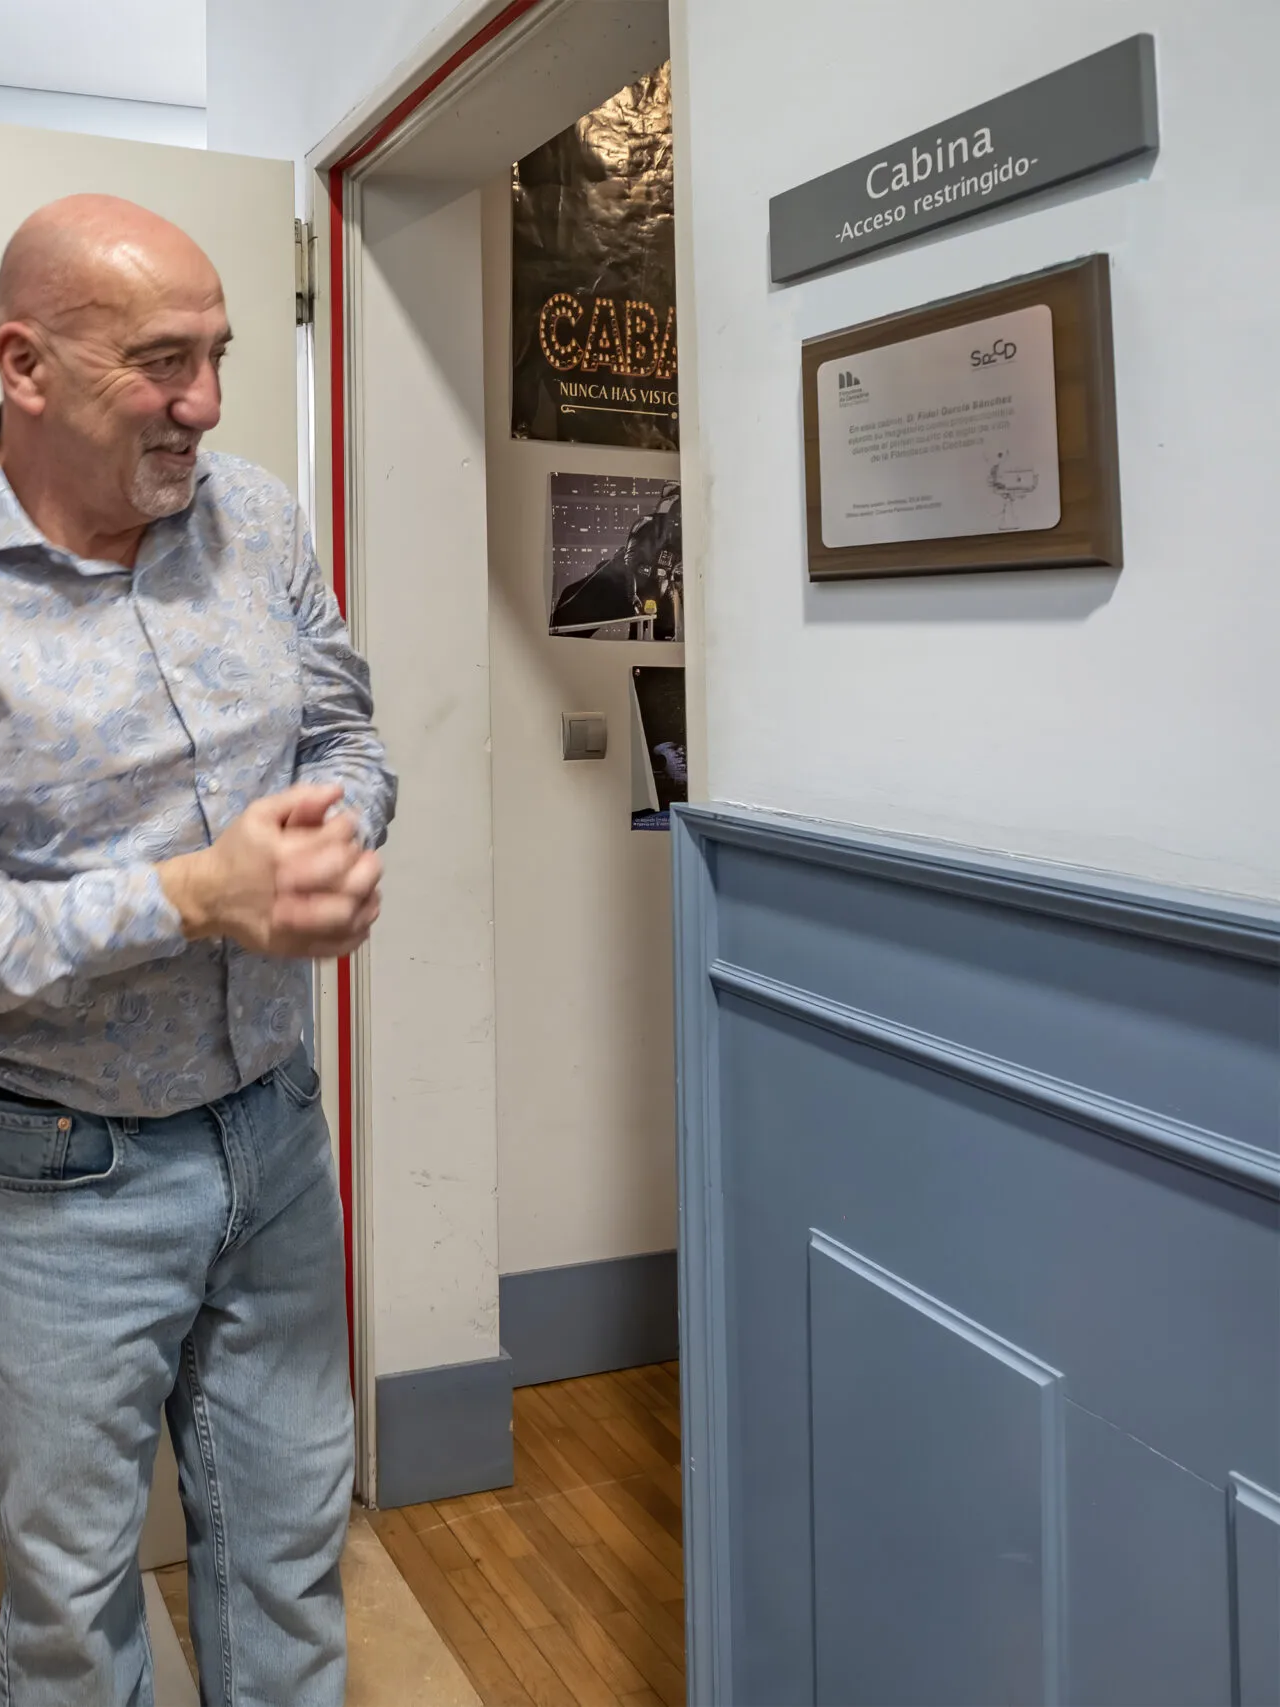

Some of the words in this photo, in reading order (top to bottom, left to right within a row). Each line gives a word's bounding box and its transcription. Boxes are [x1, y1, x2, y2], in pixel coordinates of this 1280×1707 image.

[866, 126, 994, 199] Cabina
[835, 204, 906, 243] -Acceso
[914, 156, 1039, 215] restringido-
[560, 381, 609, 400] NUNCA
[611, 386, 638, 403] HAS
